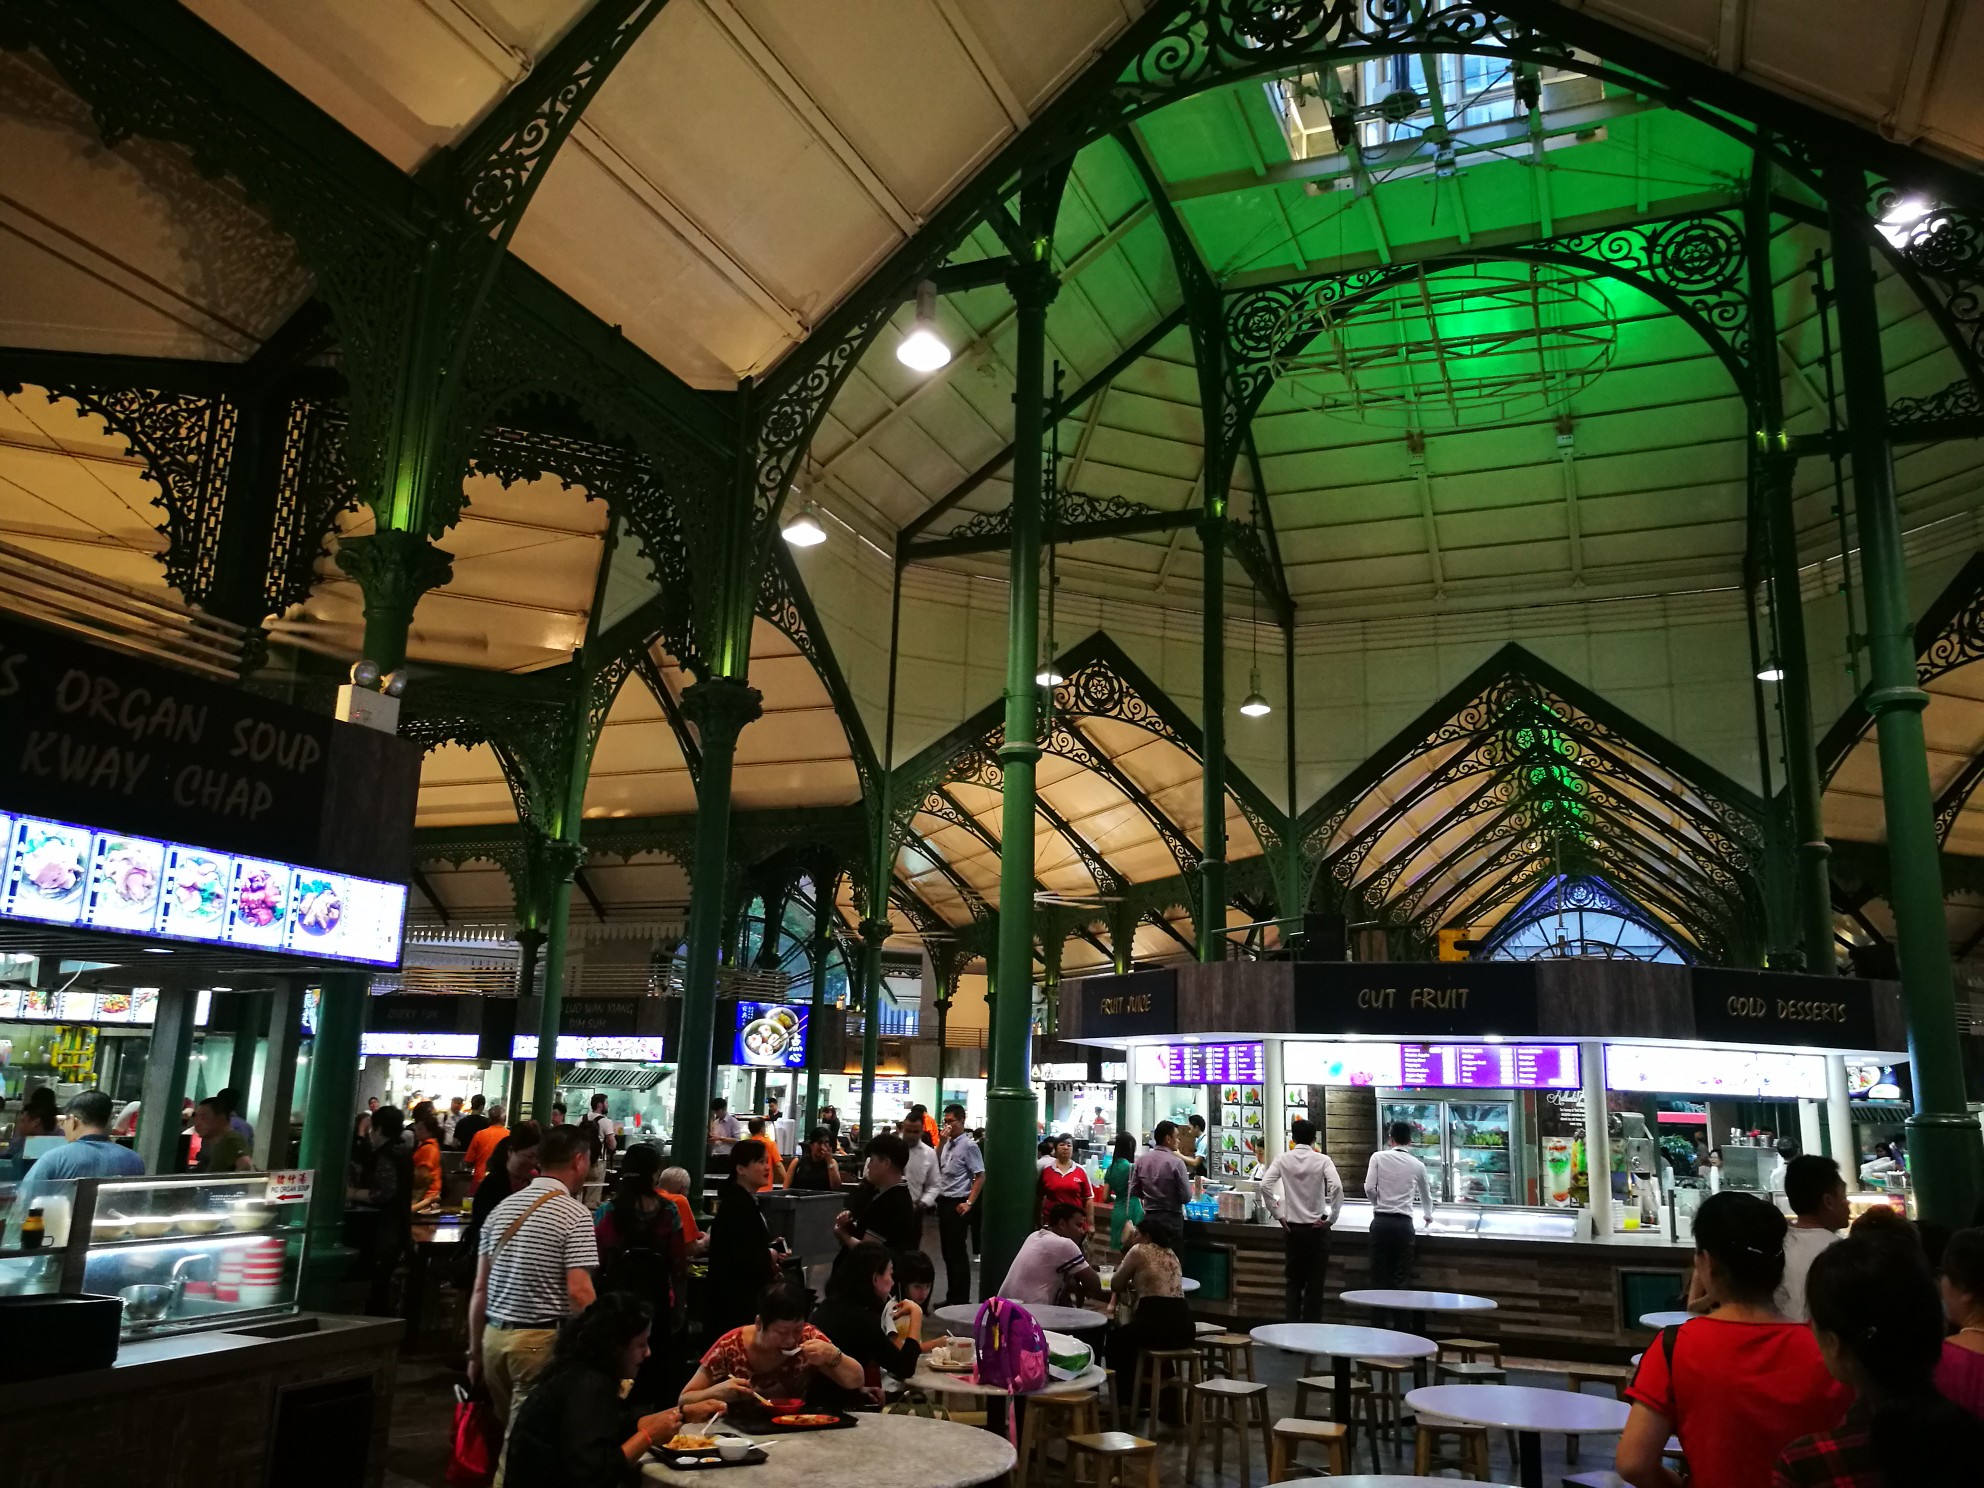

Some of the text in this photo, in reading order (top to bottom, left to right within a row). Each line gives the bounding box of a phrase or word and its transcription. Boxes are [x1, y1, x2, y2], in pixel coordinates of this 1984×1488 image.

[55, 668, 209, 744] ORGAN
[229, 717, 321, 773] SOUP
[20, 730, 274, 821] KWAY CHAP
[584, 1002, 605, 1014] WAN
[607, 1002, 635, 1015] XIANG
[1100, 993, 1152, 1015] FRUIT JUICE
[1357, 988, 1470, 1009] CUT FRUIT
[1726, 995, 1849, 1023] COLD DESSERTS
[569, 1017, 607, 1029] DIM SUM
[297, 1184, 310, 1192] SOUP
